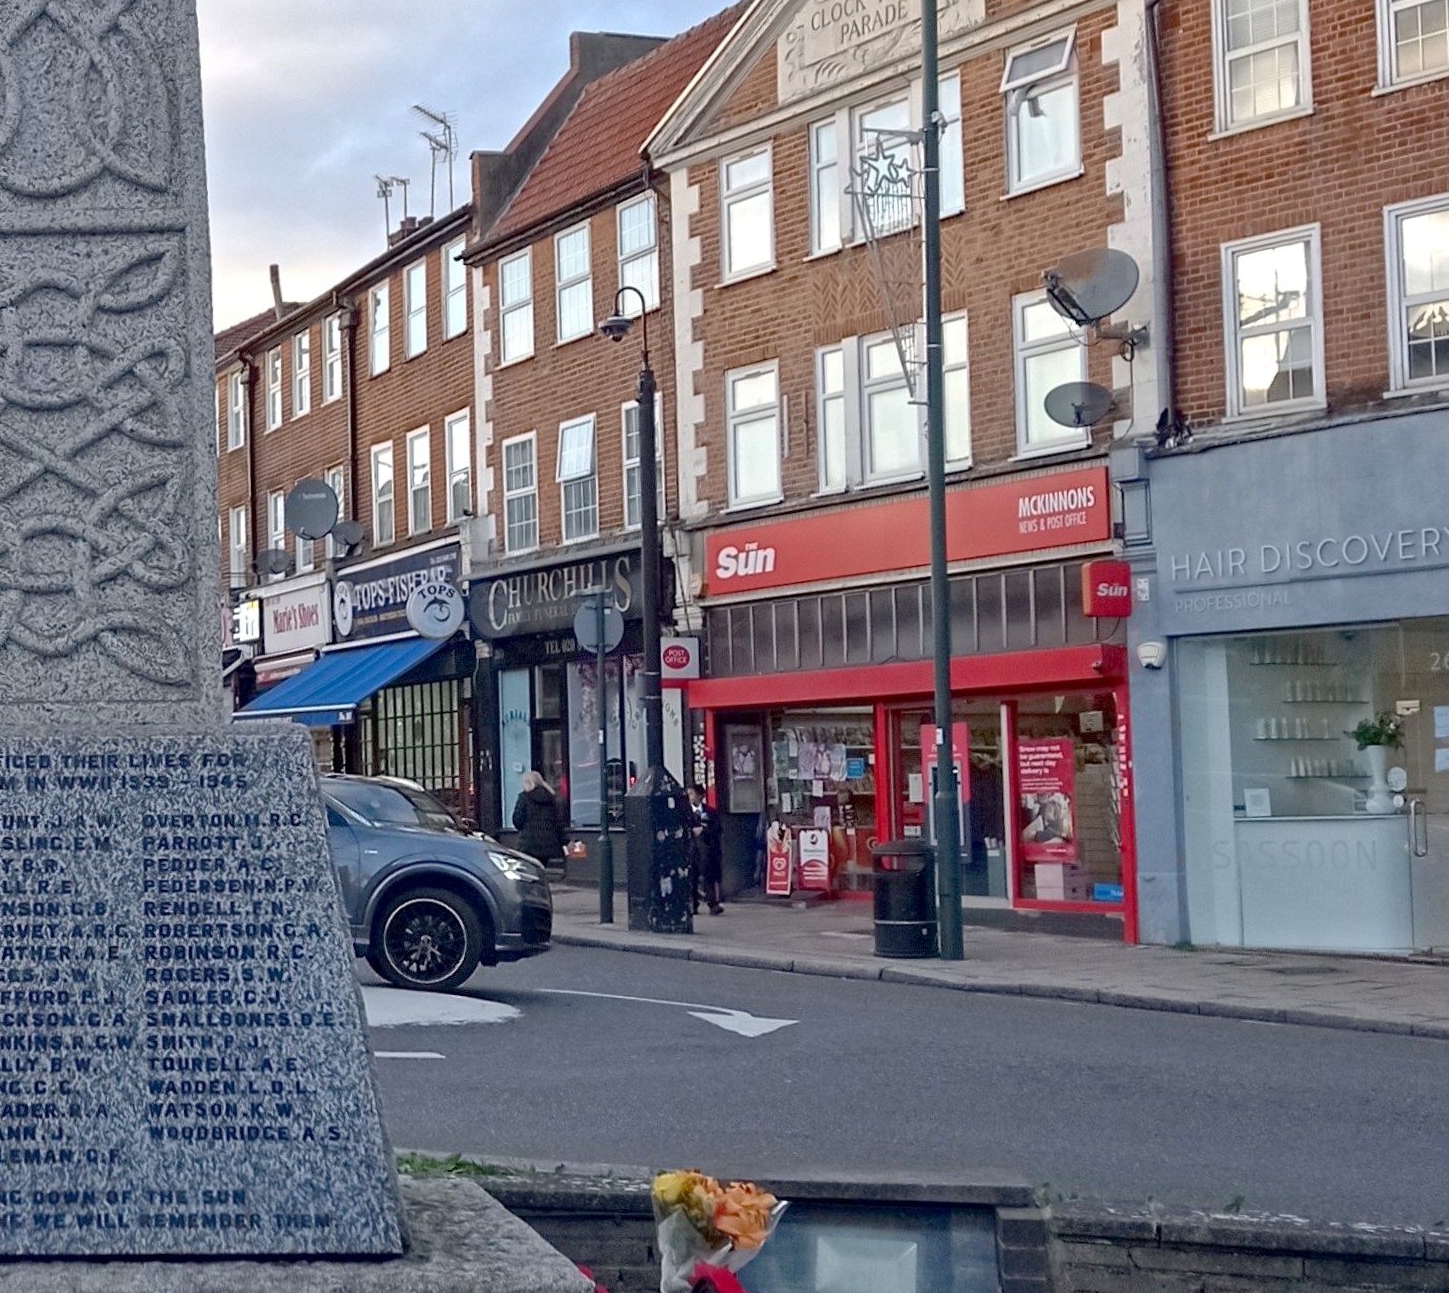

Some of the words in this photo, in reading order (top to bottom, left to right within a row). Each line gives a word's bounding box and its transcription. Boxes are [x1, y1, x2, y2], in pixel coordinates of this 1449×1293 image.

[1018, 485, 1095, 518] MCKINNONS
[1019, 519, 1038, 534] NEWS
[1040, 517, 1046, 531] &
[1047, 514, 1064, 529] POST
[1064, 511, 1087, 527] OFFICE
[715, 546, 775, 579] Sun
[1171, 548, 1247, 581] HAIR
[417, 583, 455, 601] TOPS
[488, 556, 632, 631] CHURCHILLS
[1096, 582, 1128, 597] Sun
[1174, 590, 1292, 613] PROFESSIONAL
[273, 606, 296, 634] Marie's
[298, 602, 319, 629] Shoes
[545, 641, 560, 654] TEL
[668, 649, 685, 657] POST
[665, 655, 688, 664] OFFICE
[63, 754, 118, 768] THEIR
[129, 754, 190, 768] LIVES
[202, 753, 247, 767] FOR
[27, 776, 49, 790] IN
[58, 775, 111, 790] WWII
[121, 775, 169, 789] 1939
[200, 775, 247, 789] 1945
[33, 1190, 95, 1204] DOWN
[106, 1190, 132, 1204] OF
[149, 1190, 188, 1205] THE
[202, 1190, 246, 1205] SUN
[34, 1214, 66, 1229] WE
[76, 1214, 130, 1229] WILL
[138, 1213, 261, 1228] REMEMBER
